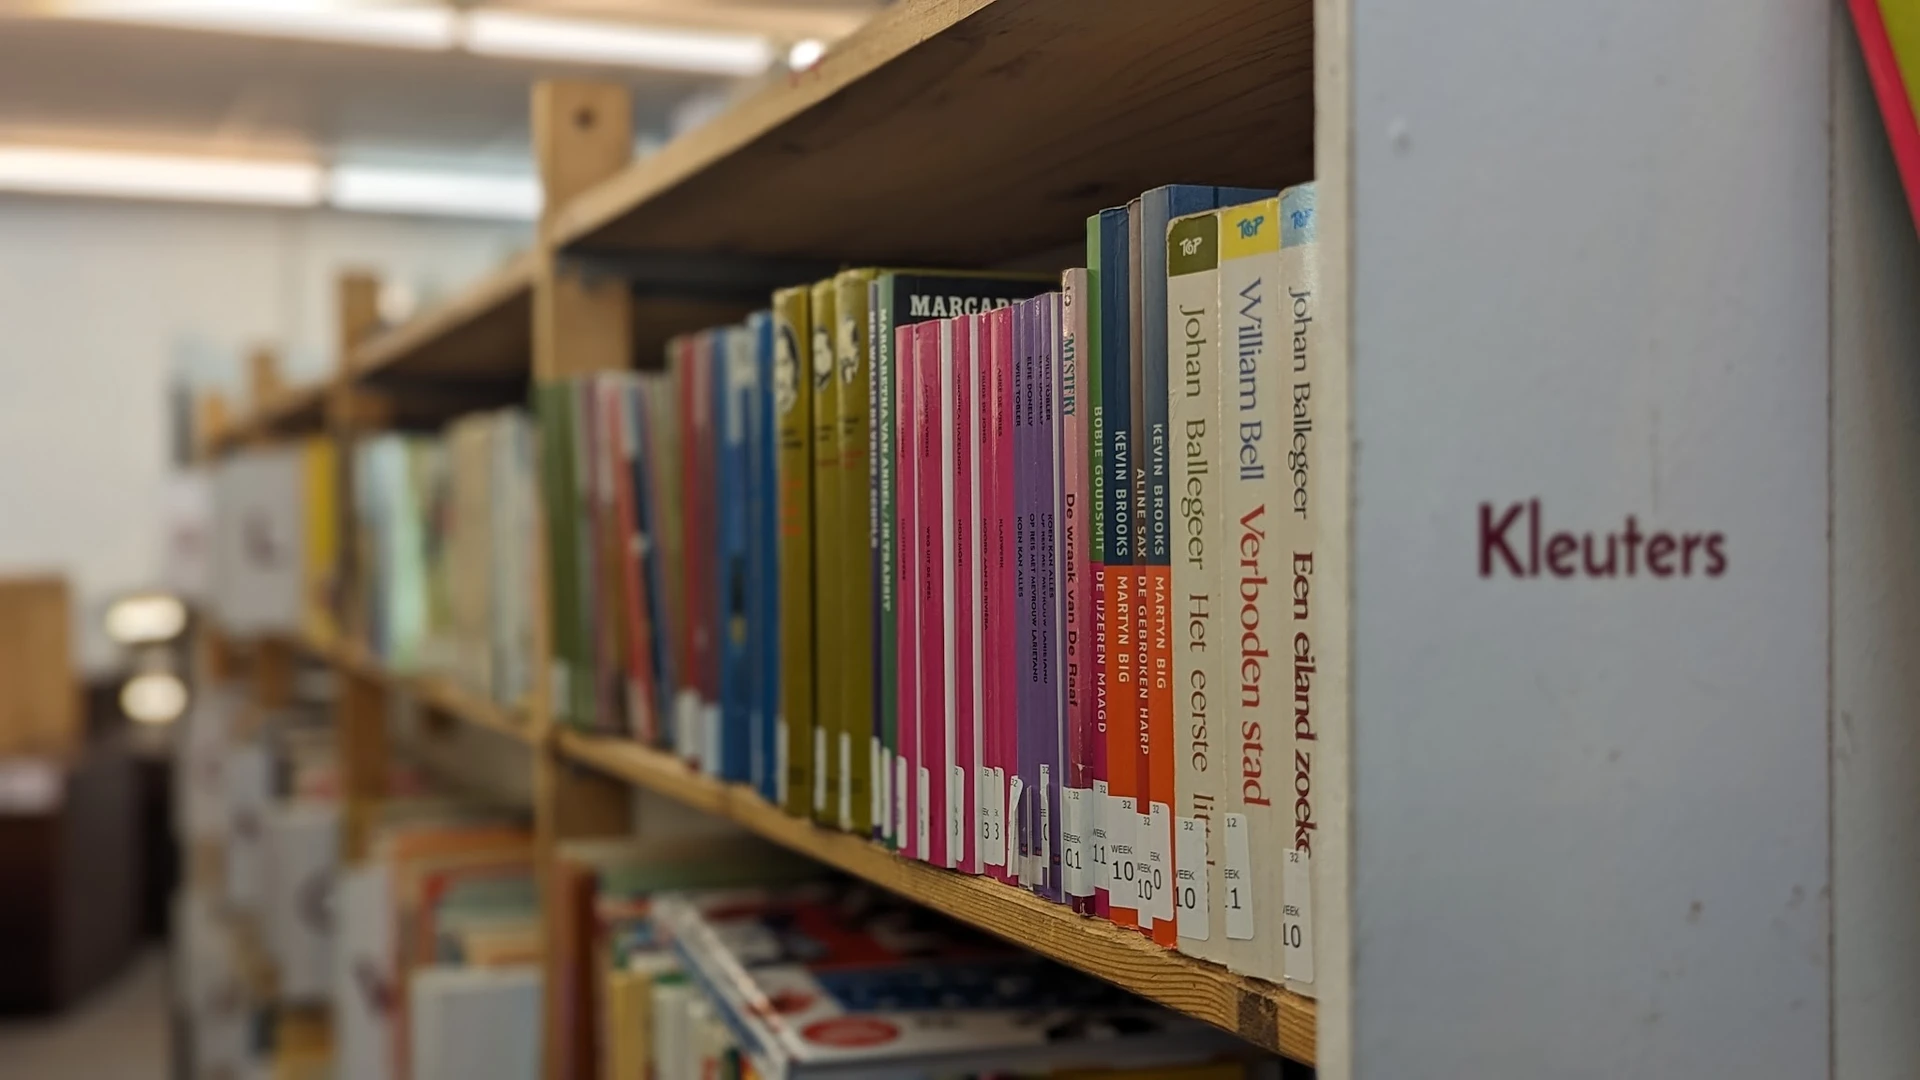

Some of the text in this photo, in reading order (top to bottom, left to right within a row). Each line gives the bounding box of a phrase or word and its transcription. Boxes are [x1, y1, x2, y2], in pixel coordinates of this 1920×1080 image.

[1179, 237, 1203, 257] TOP
[1236, 215, 1264, 239] TOP
[1179, 304, 1207, 398] Johan
[1288, 286, 1312, 371] Johan
[880, 308, 889, 419] MARGARETHA
[881, 422, 889, 452] VAN
[1288, 382, 1312, 520] Ballegeer
[1029, 513, 1035, 528] OP
[1180, 418, 1209, 570] Ballegeer
[1114, 430, 1130, 684] KEVIN BROOKS MARTYN BIG
[1152, 423, 1167, 690] KEVIN BROOKS MARTYN BIG
[1238, 278, 1271, 807] William Bell Verboden stad
[1478, 497, 1729, 579] Kleuters
[1093, 406, 1107, 733] BOBJE GOUDSMIT DE IJZEREN MAAGD
[1292, 551, 1314, 620] Een
[1066, 492, 1078, 707] De wraak van De Raaf
[1136, 467, 1149, 756] ALINE SAX DE GEBROKEN HARP
[1189, 593, 1209, 652] Het
[1293, 632, 1318, 740] eiland
[1191, 669, 1209, 772] eerste
[1099, 784, 1107, 794] 32
[1122, 800, 1132, 810] 32
[1152, 804, 1160, 815] 32
[1110, 844, 1133, 855] WEEK
[1142, 816, 1151, 826] 32
[1183, 821, 1194, 831] 32
[1093, 843, 1107, 865] 11
[1112, 860, 1134, 882] 10
[1289, 851, 1299, 863] 32
[1137, 878, 1153, 901] 10
[1175, 886, 1196, 909] 10
